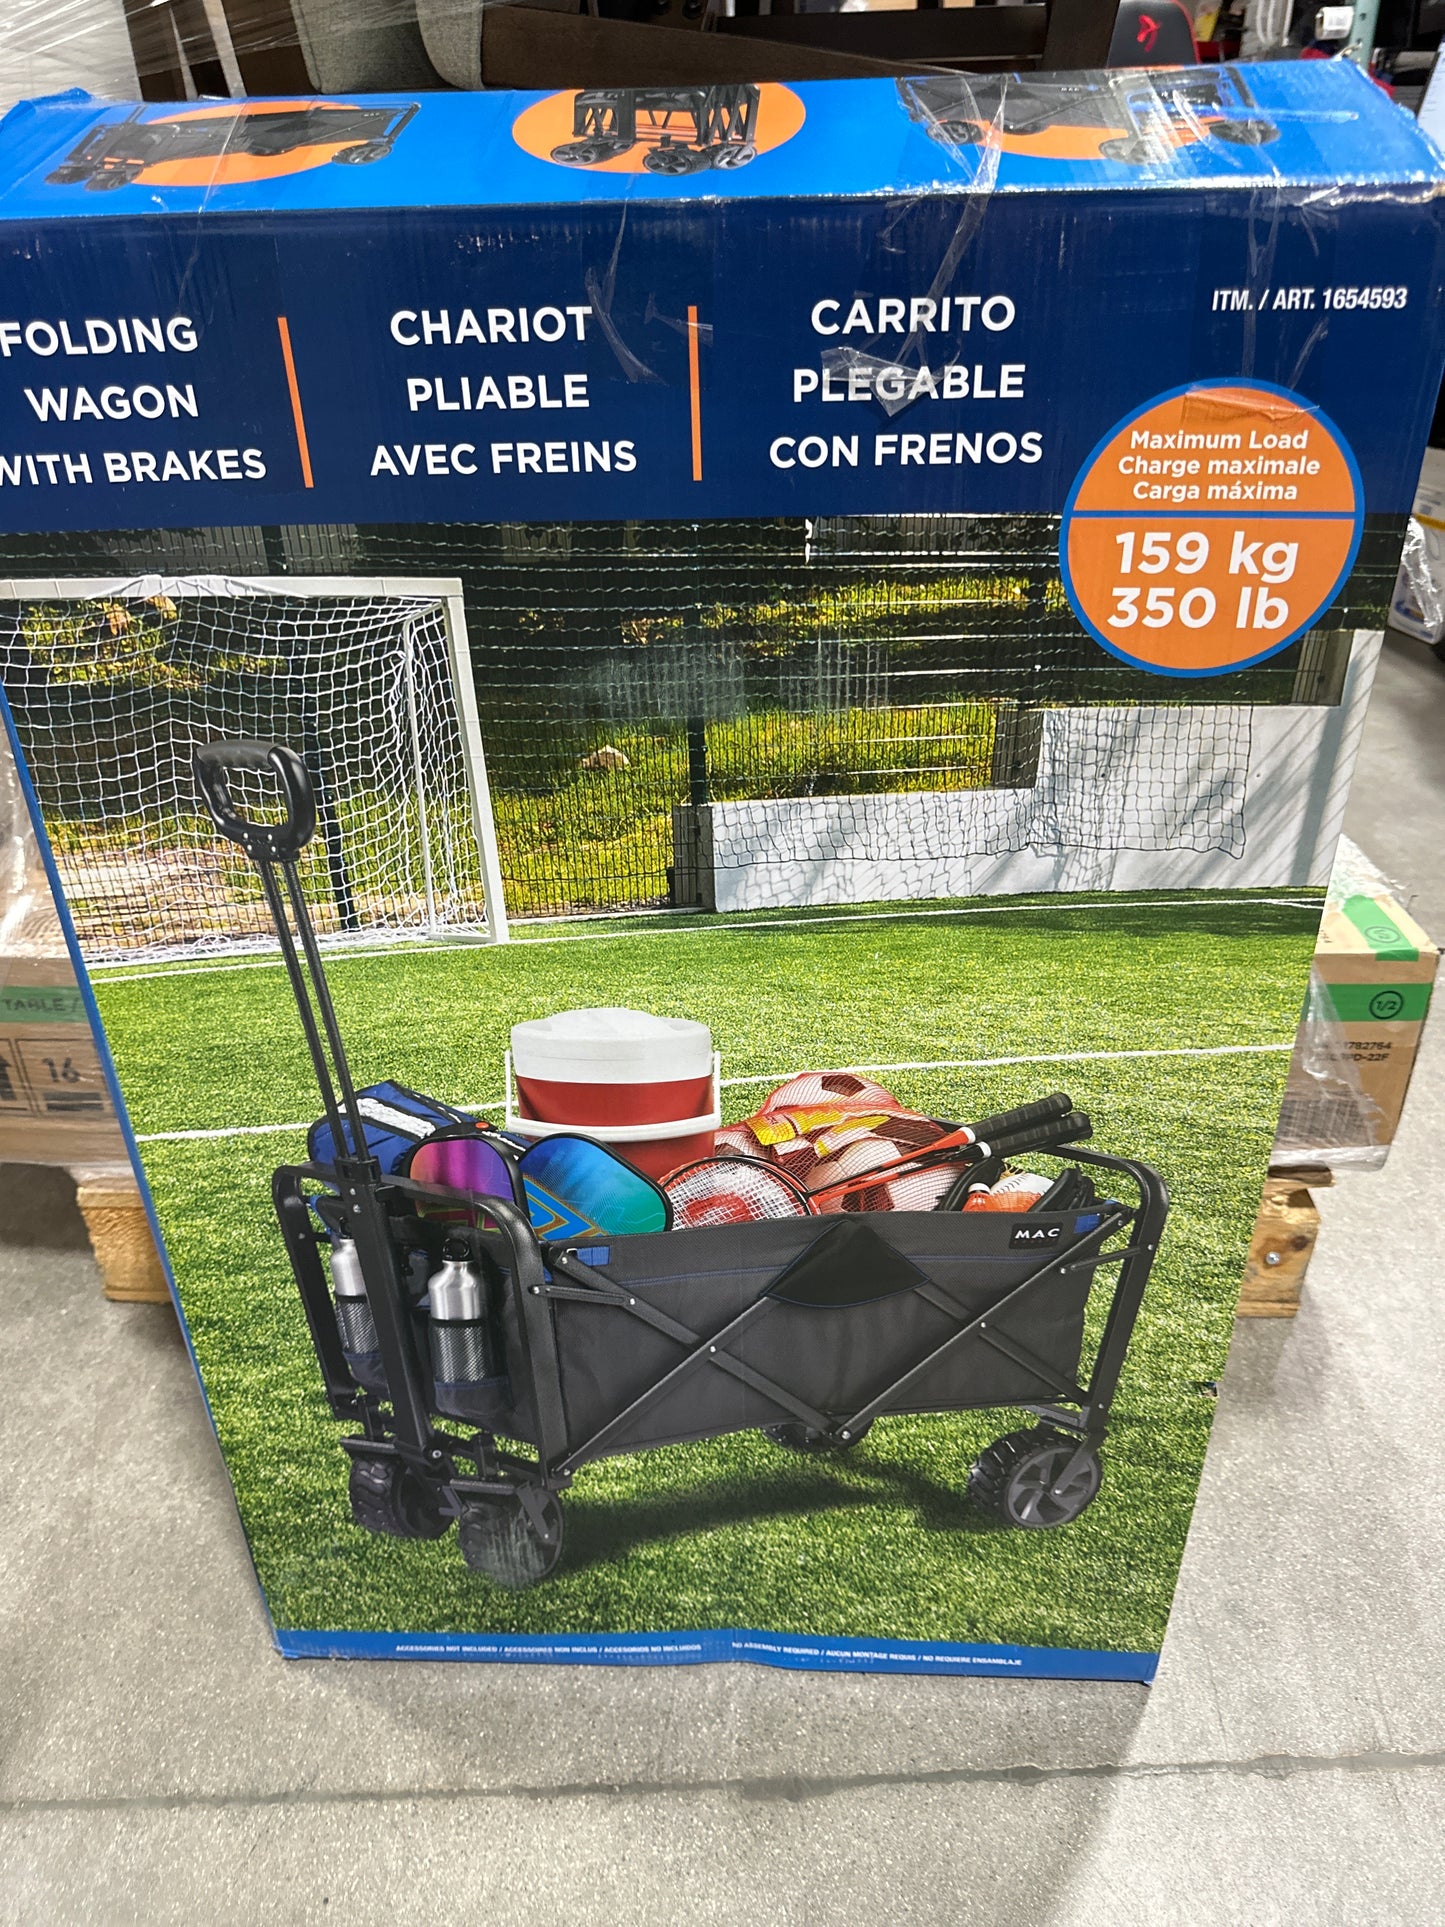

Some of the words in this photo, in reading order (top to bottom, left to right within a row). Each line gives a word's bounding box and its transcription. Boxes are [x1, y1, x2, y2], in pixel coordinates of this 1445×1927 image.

[812, 296, 1016, 334] CARRITO
[1212, 290, 1253, 311] ITM.
[1258, 289, 1269, 311] /
[1272, 289, 1315, 310] ART.
[1323, 287, 1408, 310] 1654593
[0, 317, 197, 358] FOLDING
[391, 307, 592, 345] CHARIOT
[407, 375, 590, 412] PLIABLE
[793, 364, 1026, 403] PLEGABLE
[24, 385, 198, 422] WAGON
[769, 436, 859, 469] CON
[874, 432, 1043, 466] FRENOS
[1130, 430, 1242, 449] Maximum
[1248, 430, 1309, 449] Load
[104, 449, 267, 483] BRAKES
[370, 444, 478, 476] AVEC
[491, 441, 637, 474] FREINS
[1118, 456, 1201, 478] Charge
[1207, 456, 1321, 475] maximale
[1133, 481, 1200, 503] Carga
[1207, 480, 1298, 500] máxima
[1115, 531, 1210, 574] 159
[1228, 531, 1299, 584] kg
[1107, 587, 1216, 629] 350
[1236, 587, 1289, 629] lb
[1376, 1000, 1397, 1011] 1/2
[42, 1057, 81, 1083] 16
[1014, 1228, 1060, 1239] MAC
[744, 1642, 782, 1653] ASSEMBLY
[783, 1646, 820, 1655] REQUIRED
[852, 1651, 888, 1660] MONTAGE
